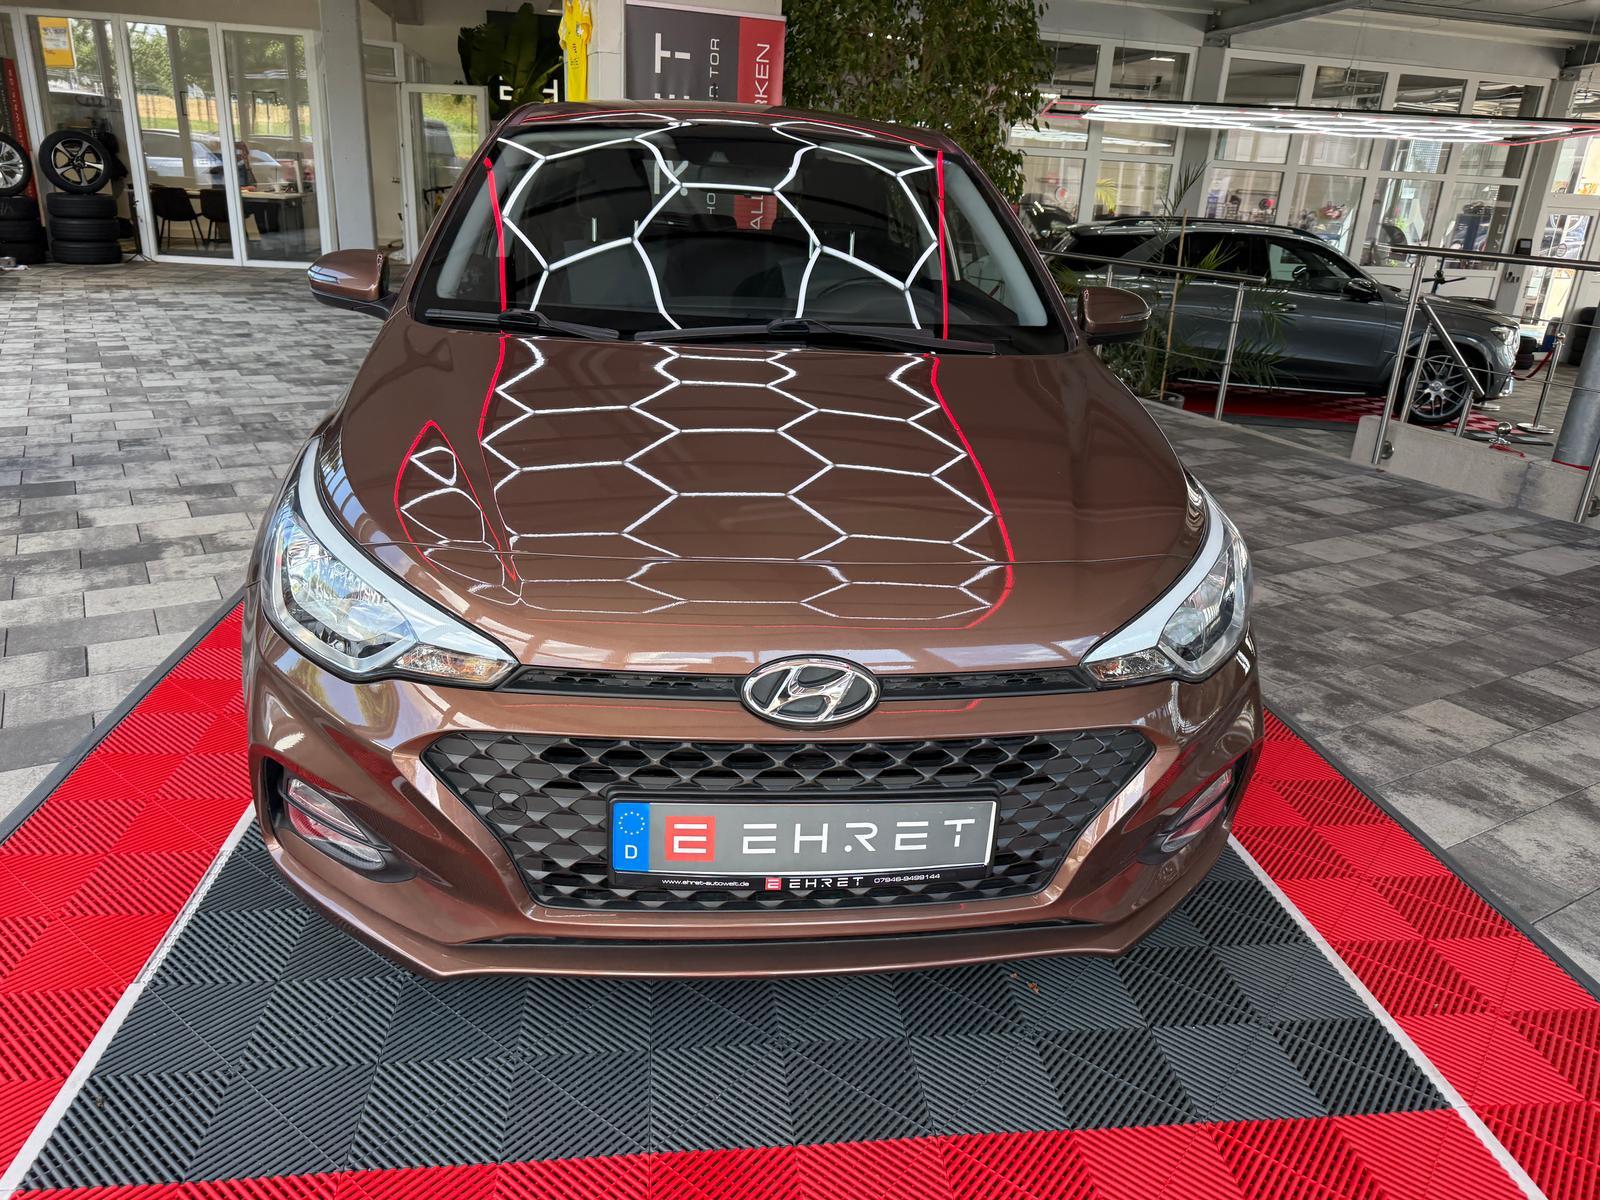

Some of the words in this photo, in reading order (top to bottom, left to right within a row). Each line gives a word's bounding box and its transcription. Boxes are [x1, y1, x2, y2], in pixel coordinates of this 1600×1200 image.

[709, 38, 720, 78] TOR
[754, 43, 770, 104] KEN
[624, 844, 638, 859] D
[742, 818, 976, 854] EHRET
[661, 879, 750, 888] www.ehret-autowelt.de
[789, 876, 864, 889] EHRET
